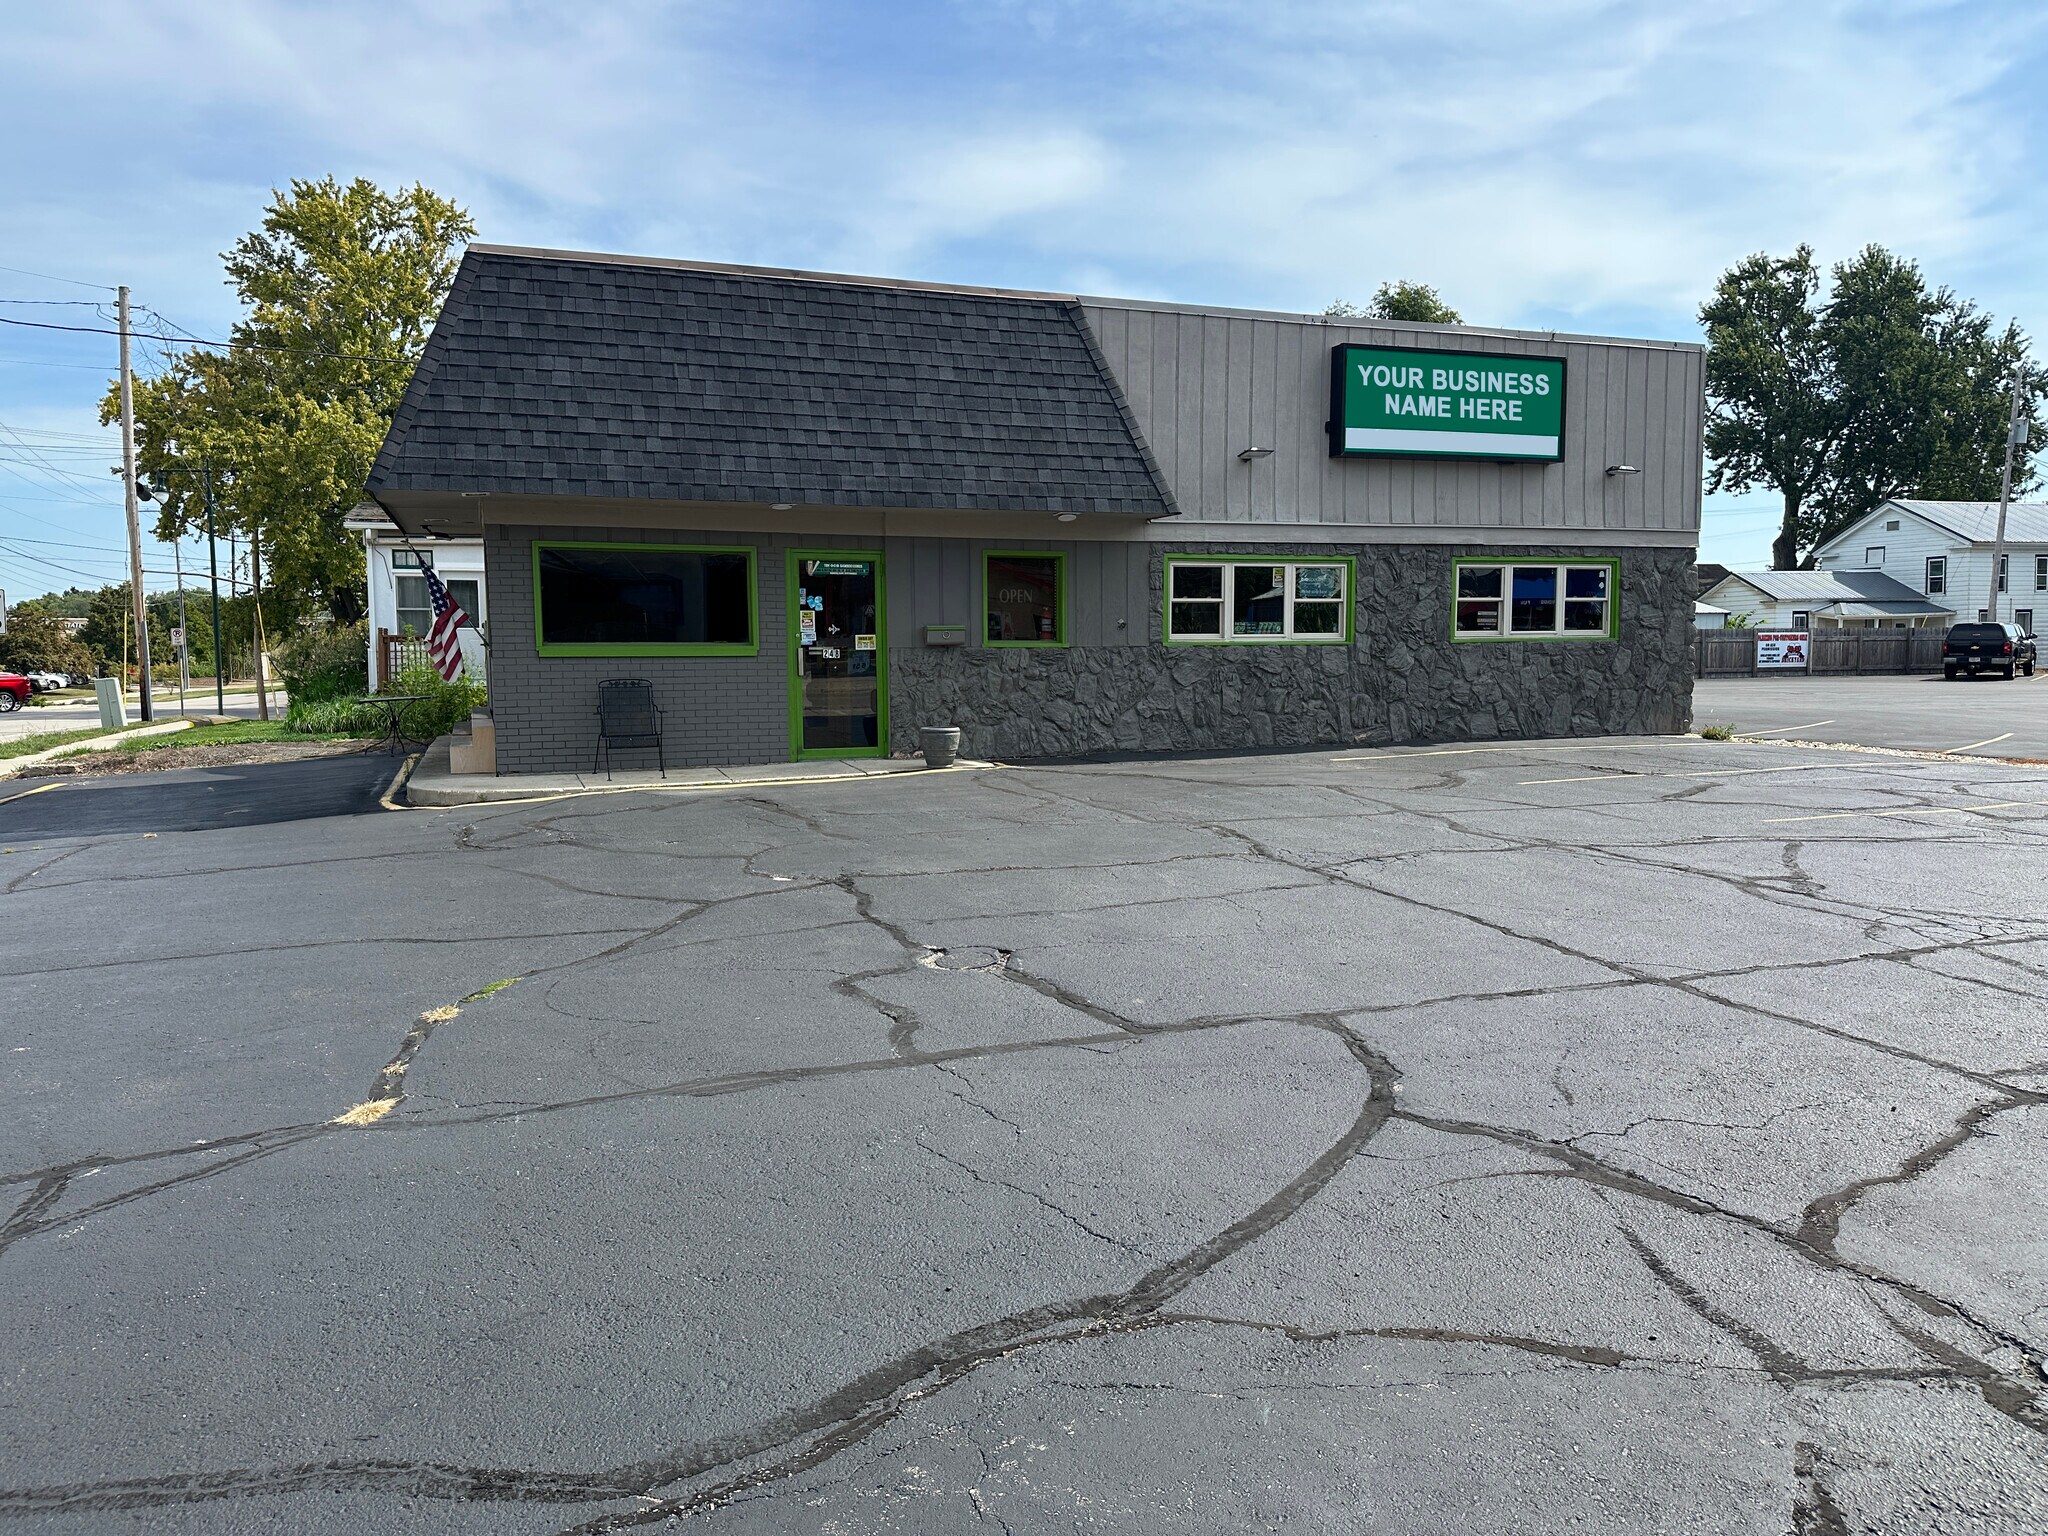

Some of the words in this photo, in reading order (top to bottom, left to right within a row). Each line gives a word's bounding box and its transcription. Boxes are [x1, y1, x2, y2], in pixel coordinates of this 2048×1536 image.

[1357, 365, 1424, 389] YOUR
[1432, 369, 1550, 395] BUSINESS
[1385, 393, 1451, 418] NAME
[1460, 398, 1523, 421] HERE
[1000, 588, 1033, 603] OPEN
